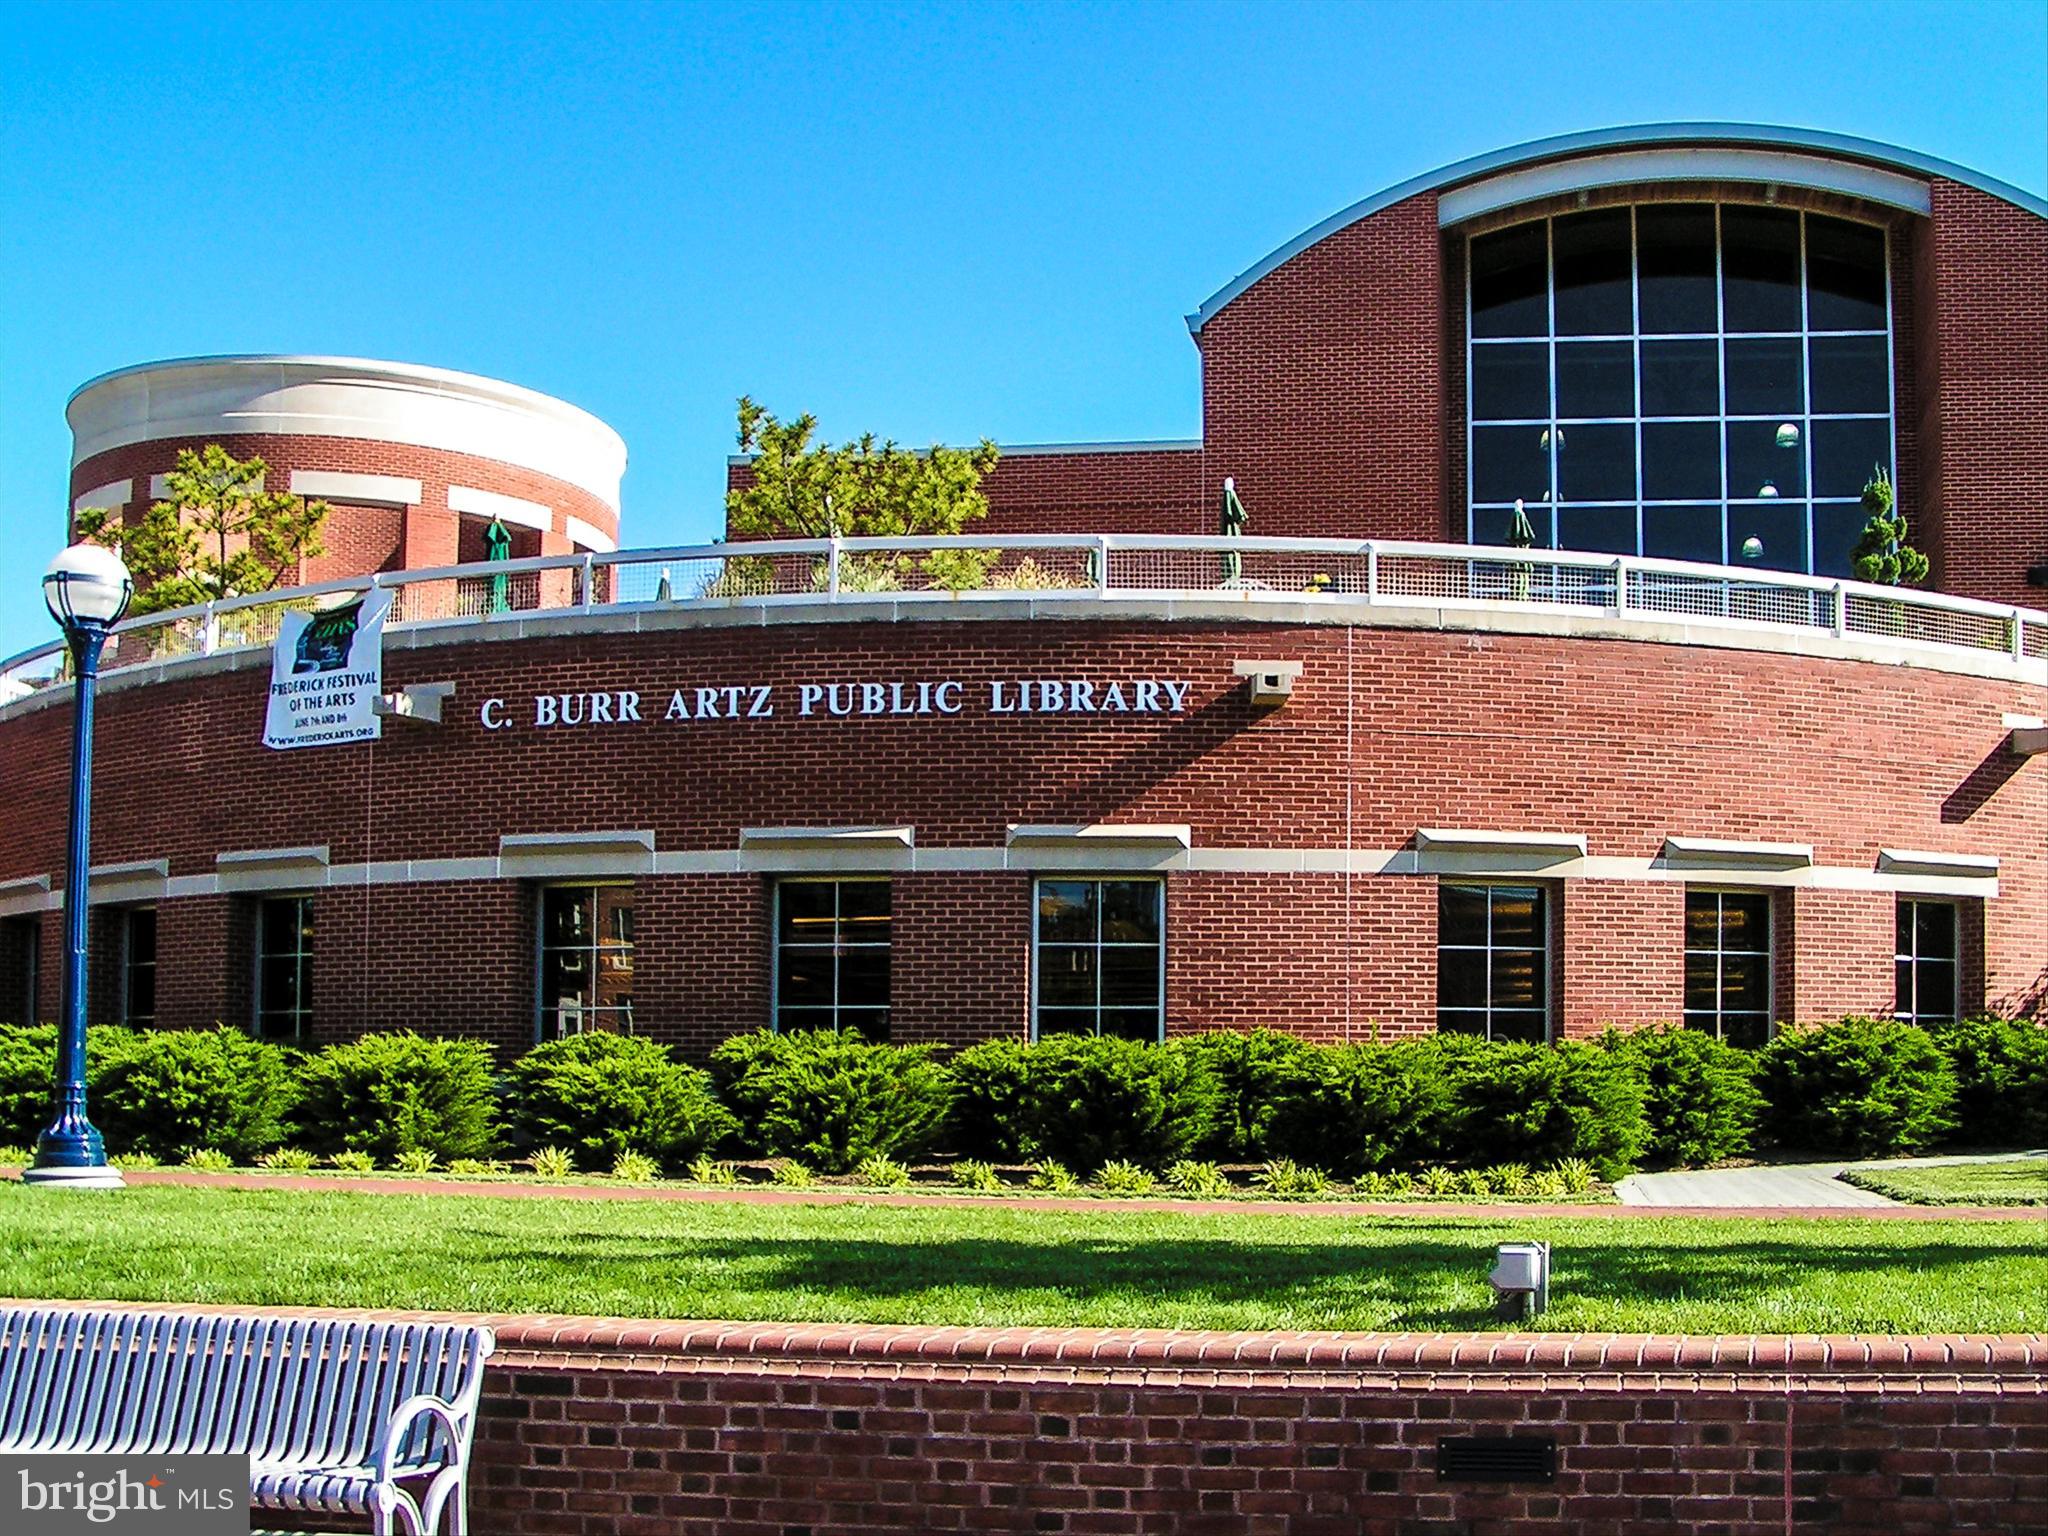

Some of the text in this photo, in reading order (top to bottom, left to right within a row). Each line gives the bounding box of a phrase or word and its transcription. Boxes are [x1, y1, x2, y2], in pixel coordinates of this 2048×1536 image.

[272, 672, 377, 695] FREDERICK FESTIVAL
[289, 693, 356, 712] OF THE ARTS
[481, 680, 1191, 729] C. BURR ARTZ PUBLIC LIBRARY
